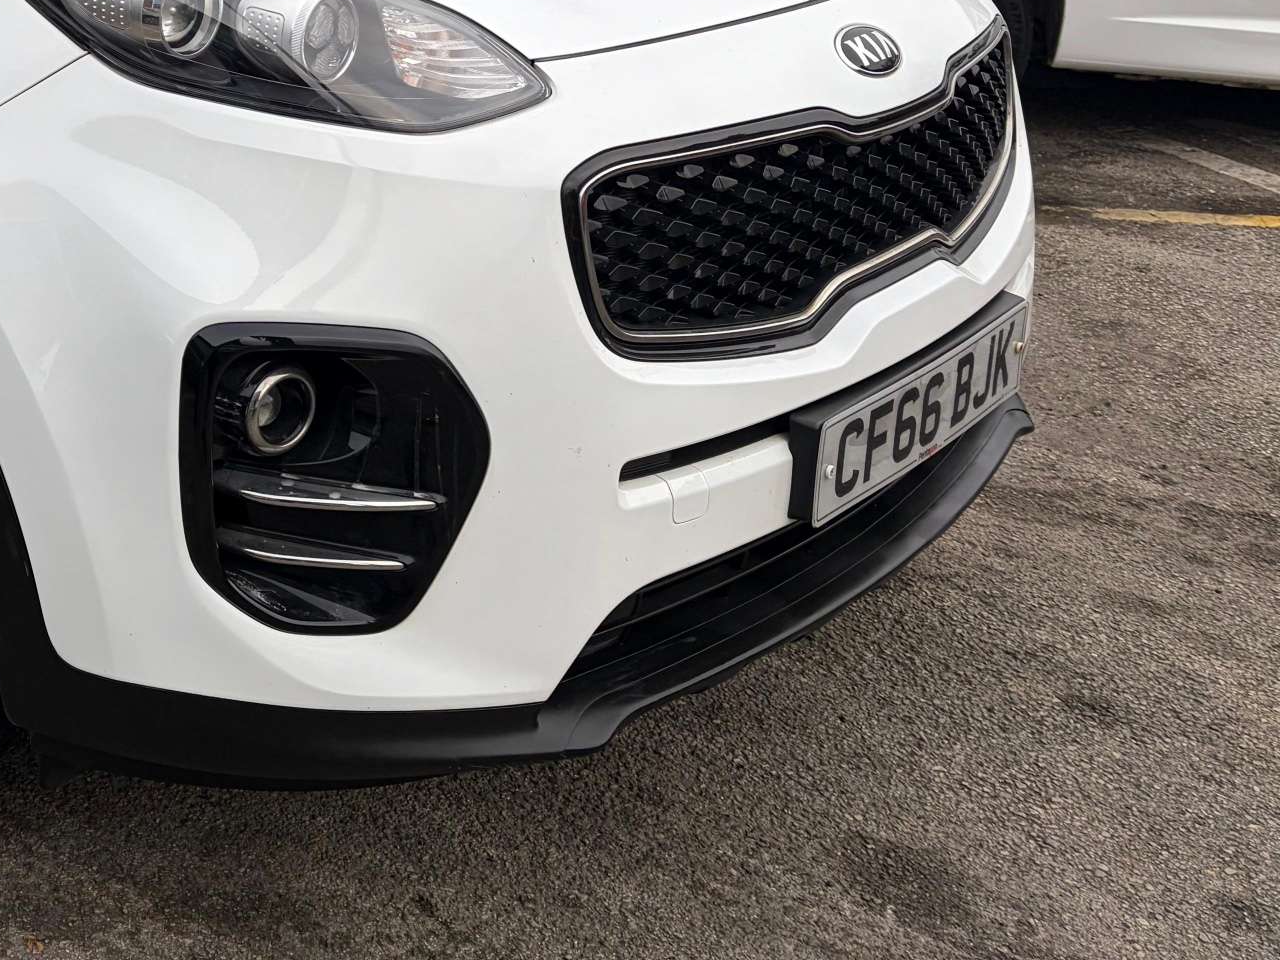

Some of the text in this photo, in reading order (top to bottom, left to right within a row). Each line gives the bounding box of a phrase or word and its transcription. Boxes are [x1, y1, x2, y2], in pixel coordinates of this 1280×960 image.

[843, 30, 899, 67] KIA
[834, 320, 1016, 498] CF66 BJK
